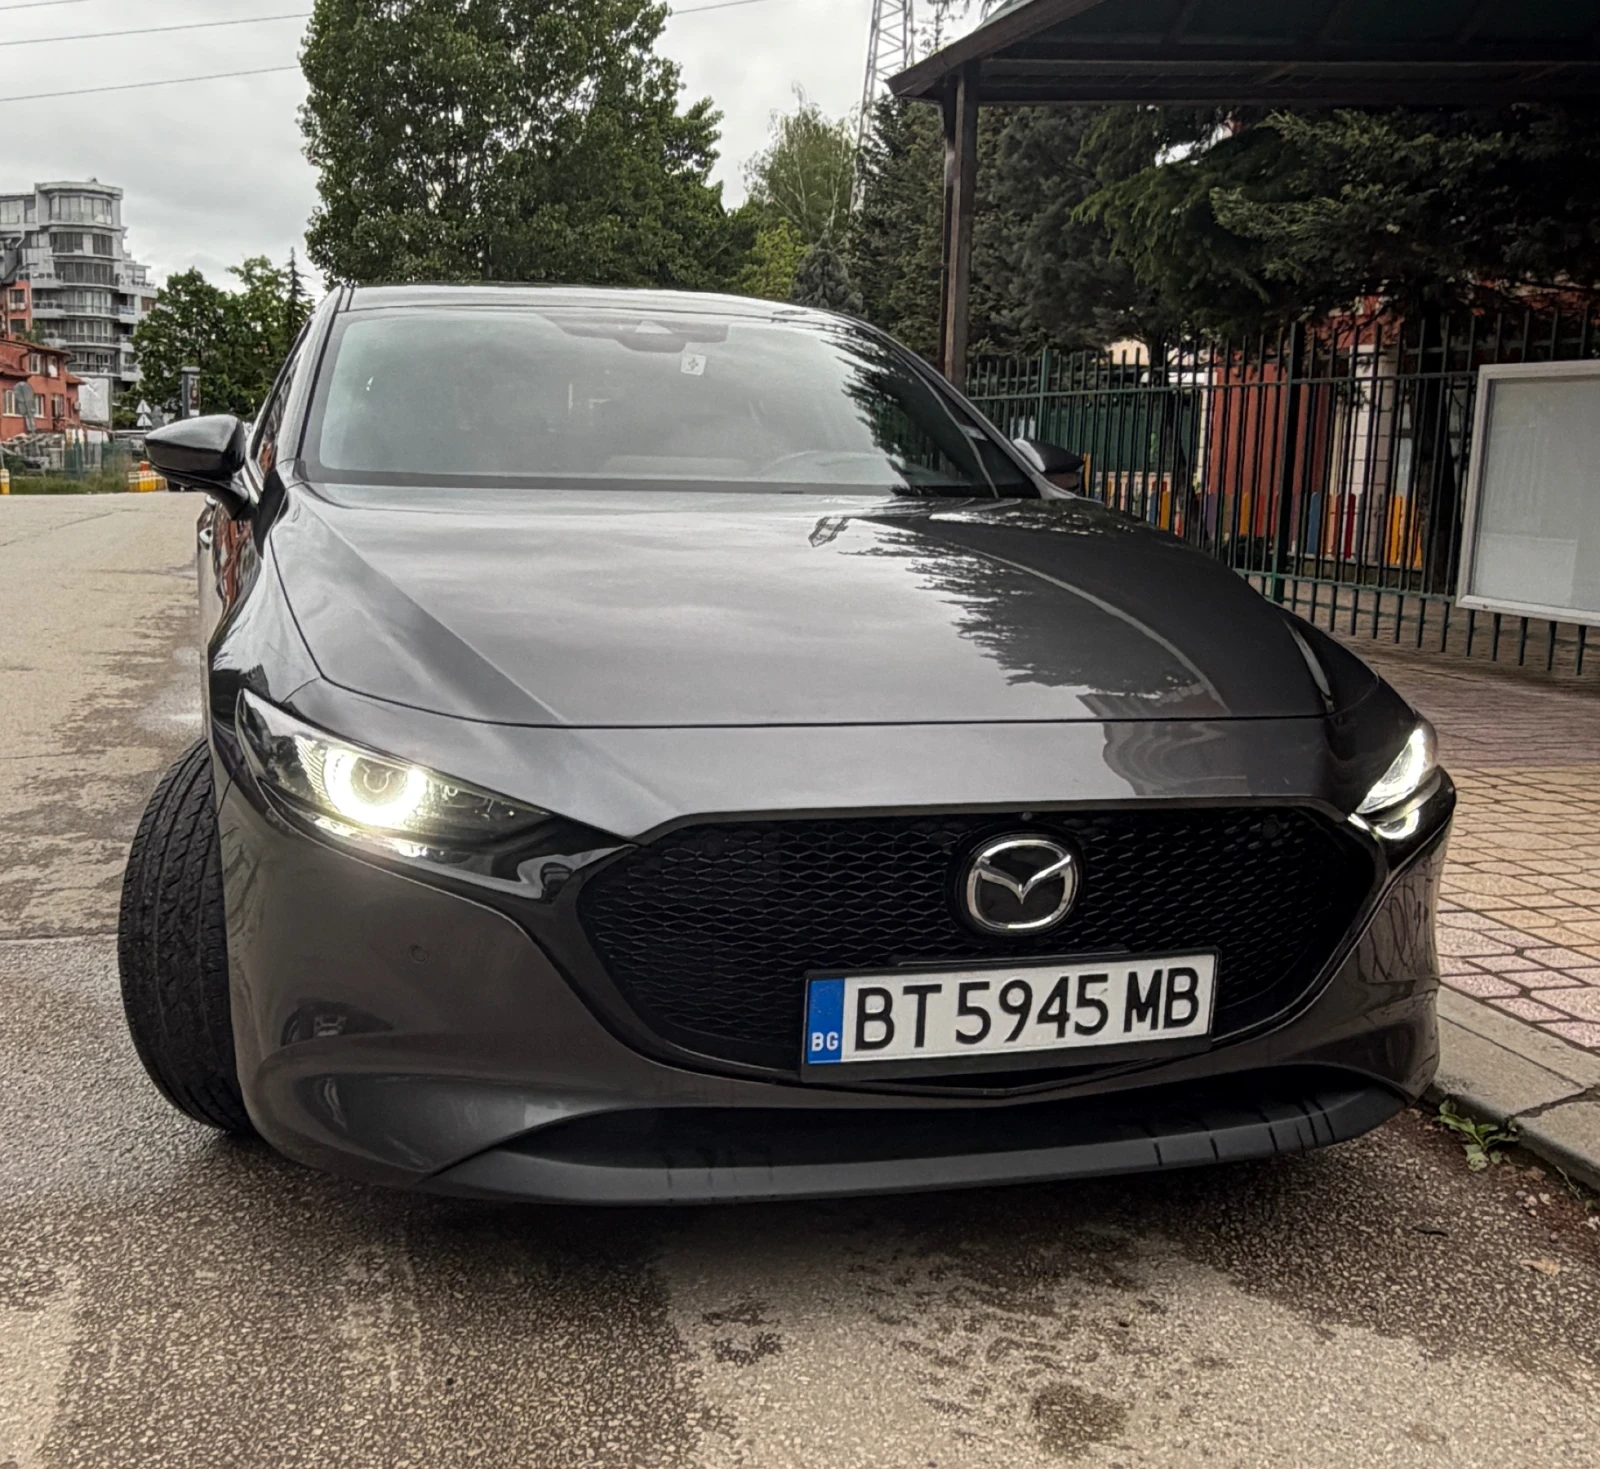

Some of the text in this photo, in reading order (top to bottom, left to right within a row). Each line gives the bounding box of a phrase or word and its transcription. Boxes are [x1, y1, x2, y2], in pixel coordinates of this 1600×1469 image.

[854, 967, 1200, 1051] BT 5945 MB
[810, 1031, 839, 1051] BG
